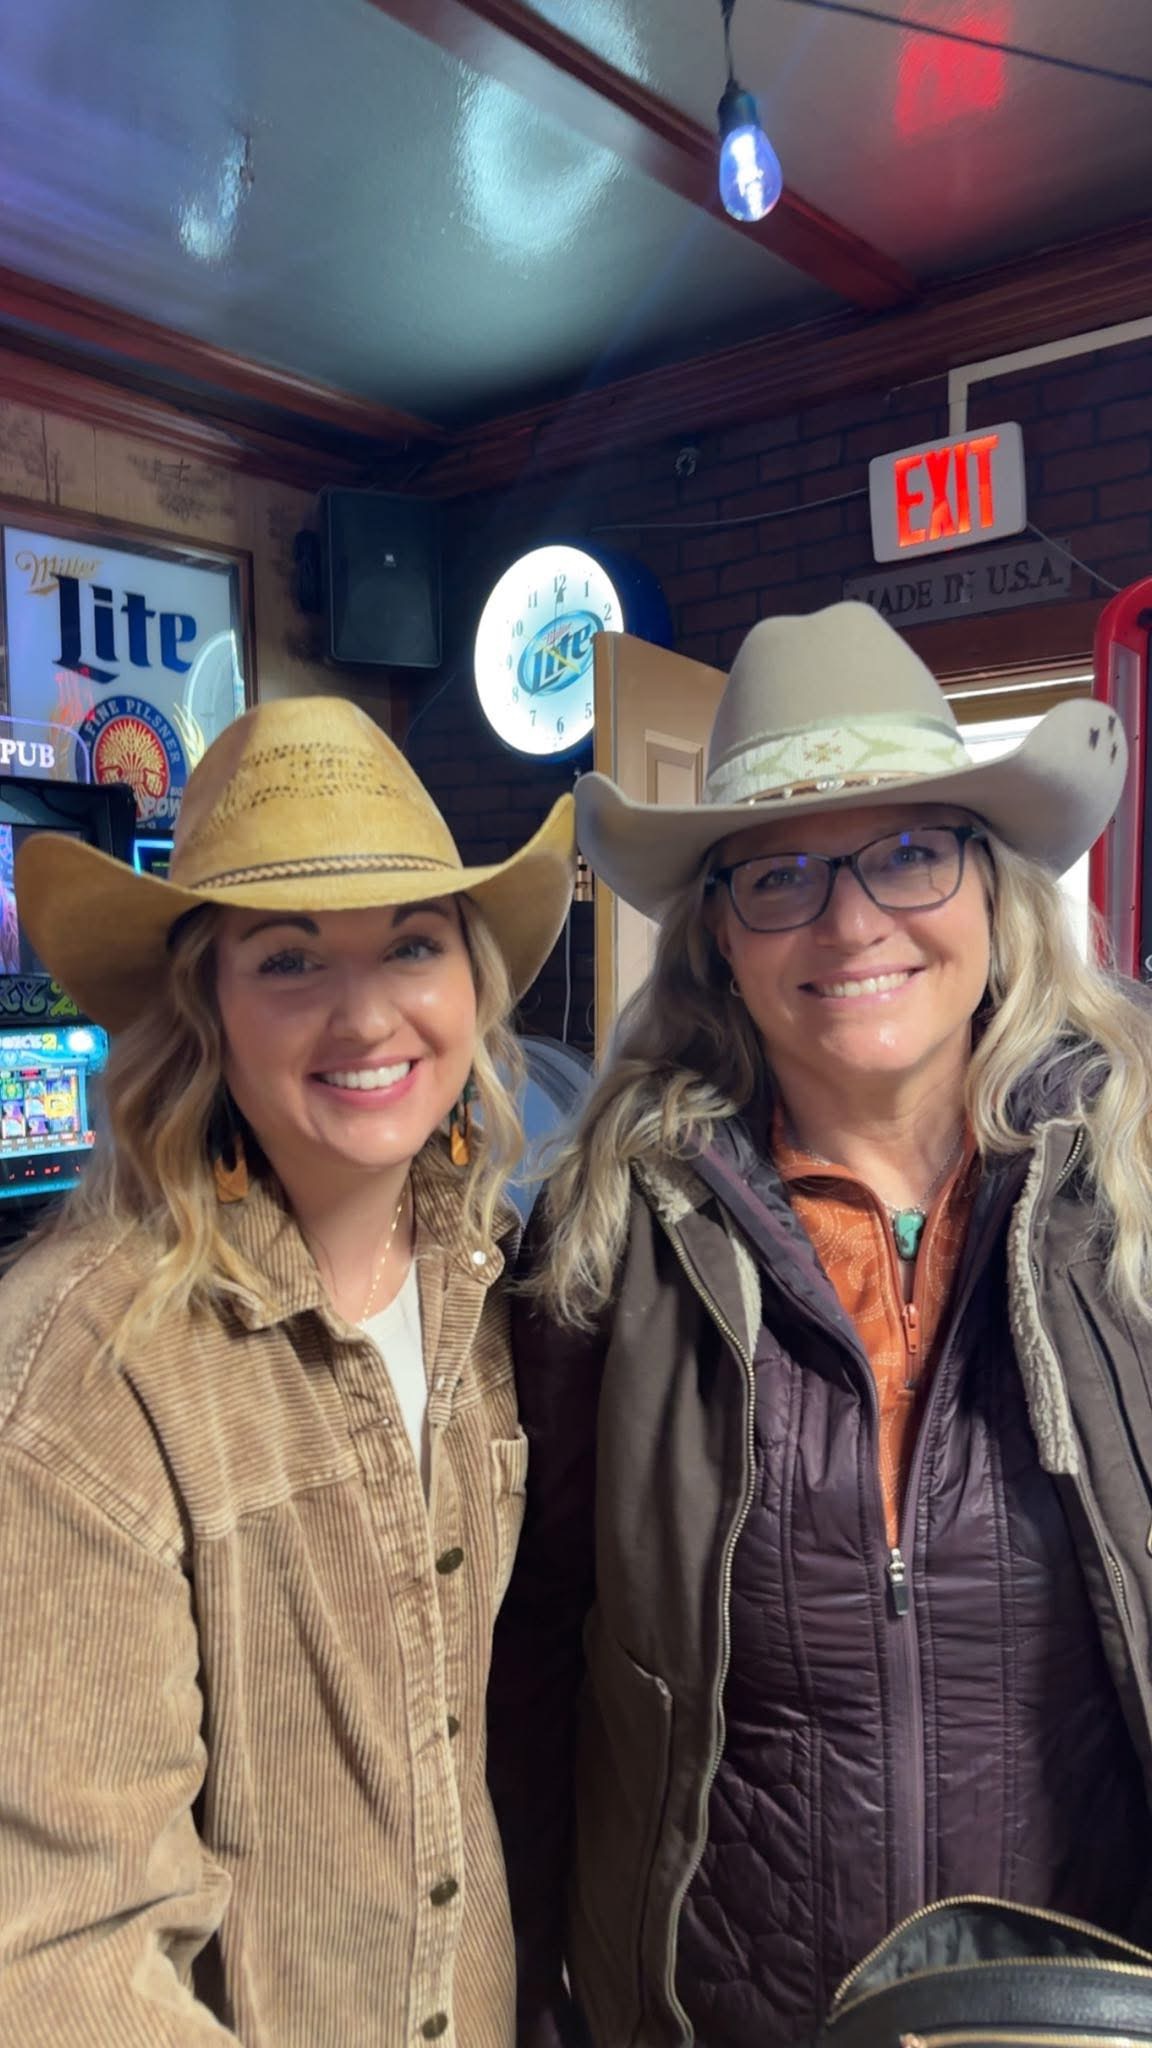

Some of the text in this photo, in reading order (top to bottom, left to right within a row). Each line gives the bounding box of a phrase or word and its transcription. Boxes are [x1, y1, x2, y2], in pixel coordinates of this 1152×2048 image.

[894, 434, 999, 547] EXIT
[553, 574, 567, 595] 12
[583, 579, 589, 598] 1
[527, 591, 538, 608] 11
[603, 603, 612, 621] 2
[51, 573, 197, 685] Lite
[529, 624, 594, 695] Lite
[530, 710, 537, 726] 7
[585, 703, 592, 719] 5
[84, 699, 182, 764] FINE PILSNER
[556, 717, 564, 734] 6
[0, 739, 55, 768] PUB
